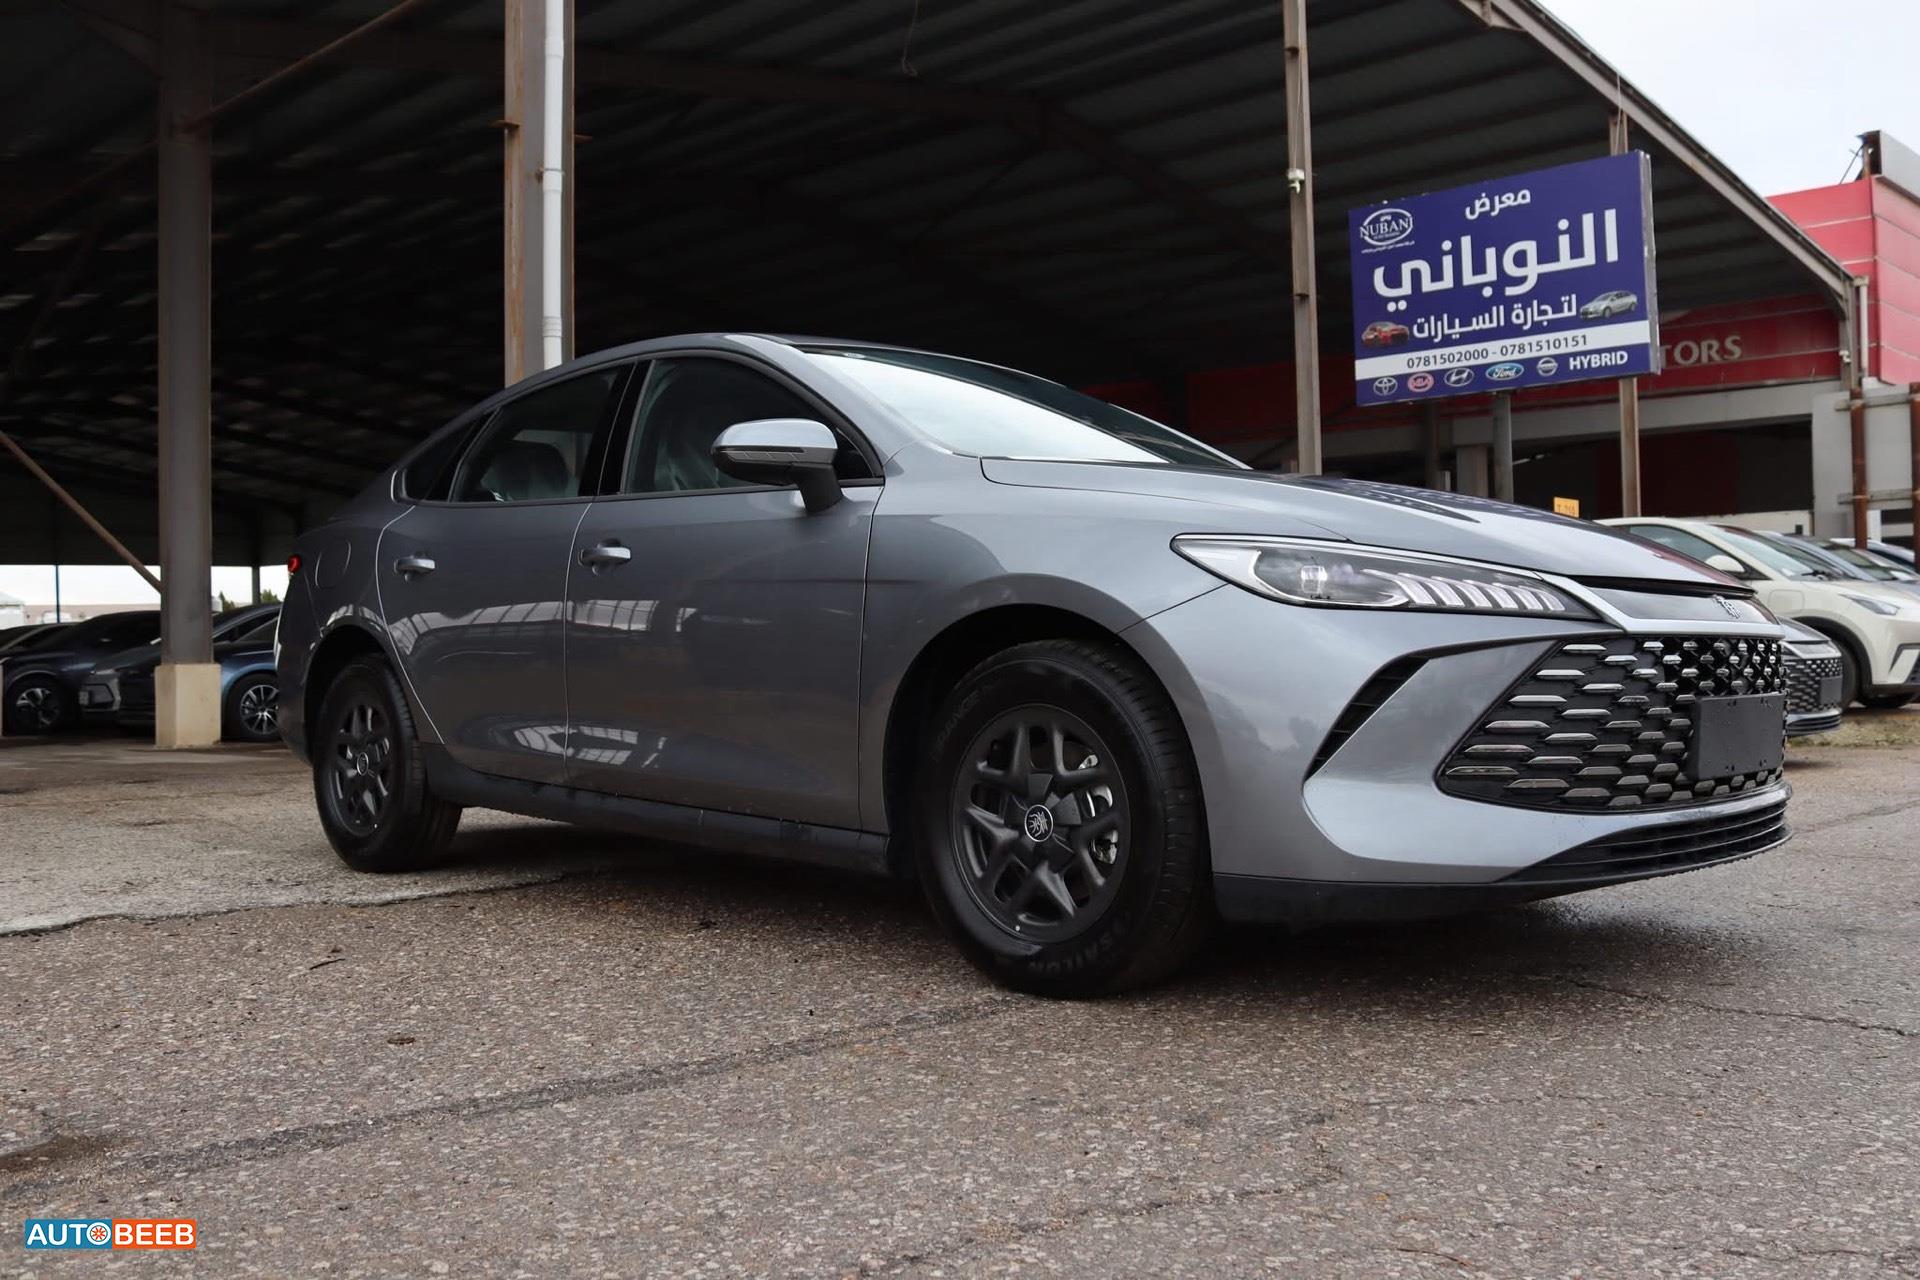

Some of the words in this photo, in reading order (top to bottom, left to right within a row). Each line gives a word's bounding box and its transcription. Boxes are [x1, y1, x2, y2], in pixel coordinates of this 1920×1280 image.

[1464, 188, 1531, 220] معرض
[1360, 217, 1408, 238] NUBAN
[1373, 208, 1619, 313] النوباني
[1412, 304, 1505, 343] السيارات
[1511, 293, 1577, 330] لتجارة
[1406, 347, 1489, 369] 0781502000
[1500, 334, 1588, 357] 0781510151
[1568, 350, 1629, 371] HYBRID
